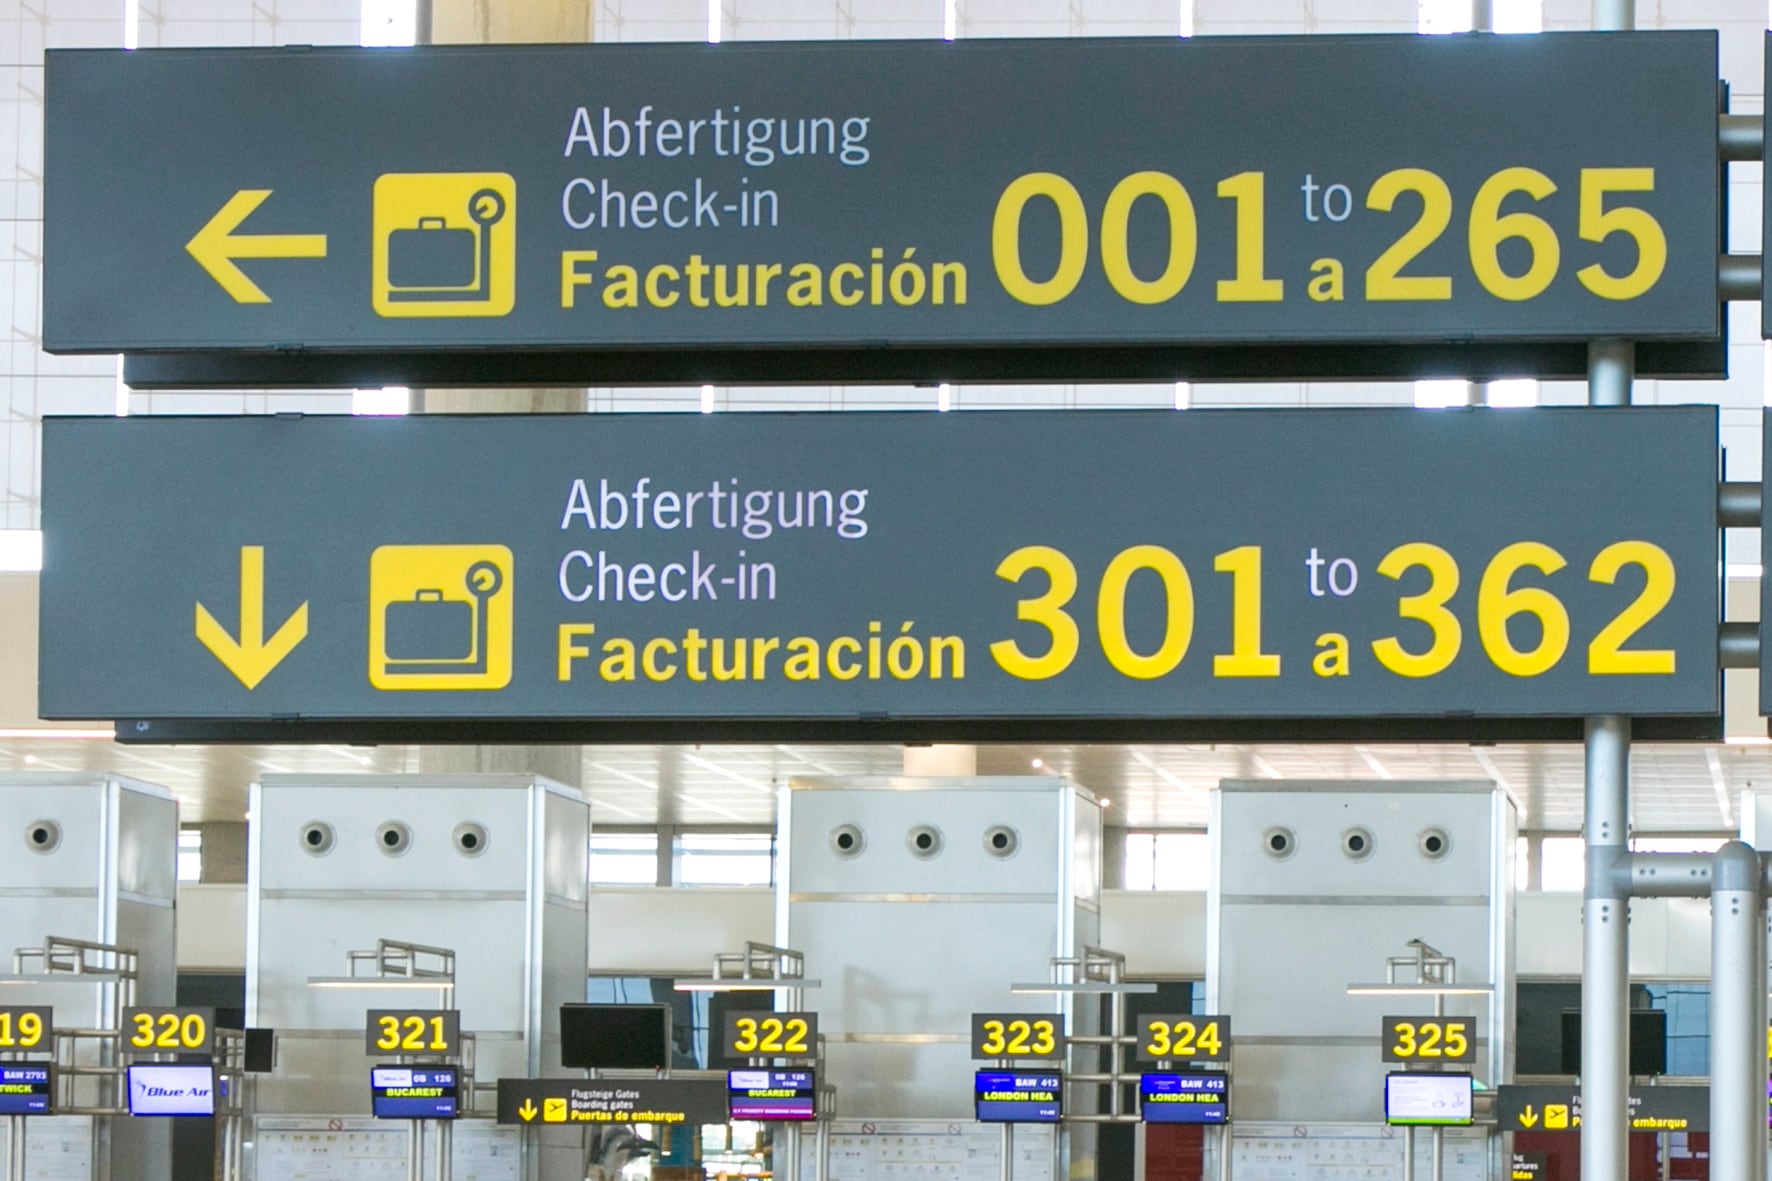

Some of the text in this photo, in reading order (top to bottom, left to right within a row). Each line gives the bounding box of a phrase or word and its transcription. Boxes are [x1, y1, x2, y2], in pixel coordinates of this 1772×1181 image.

[564, 105, 870, 164] Abfertigung
[562, 177, 778, 229] Check-in
[1301, 174, 1352, 222] to
[561, 170, 1665, 308] Facturación 001 a 265
[561, 477, 869, 539] Abfertigung
[559, 549, 776, 602] Check-in
[1305, 547, 1358, 597] to
[557, 542, 1674, 682] Facturación 301 a 362
[131, 1013, 205, 1048] 320
[377, 1016, 447, 1050] 321
[735, 1018, 808, 1052] 322
[982, 1020, 1055, 1054] 323
[1147, 1021, 1221, 1055] 324
[1393, 1024, 1467, 1057] 325
[147, 1088, 211, 1098] Blue Air
[386, 1087, 444, 1098] BUCAREST
[571, 1089, 640, 1100] Flugsteige Gates
[748, 1089, 797, 1098] BUCAREST
[984, 1091, 1054, 1102] LONDON HEA
[1015, 1078, 1037, 1088] BAW
[1040, 1078, 1059, 1088] 413
[1149, 1093, 1219, 1103] LONDON HEA
[1180, 1080, 1203, 1089] BAW
[1206, 1080, 1224, 1089] 413
[571, 1100, 634, 1111] Boarding gates
[571, 1111, 685, 1123] Puertas de embarque
[1633, 1117, 1688, 1130] embarque
